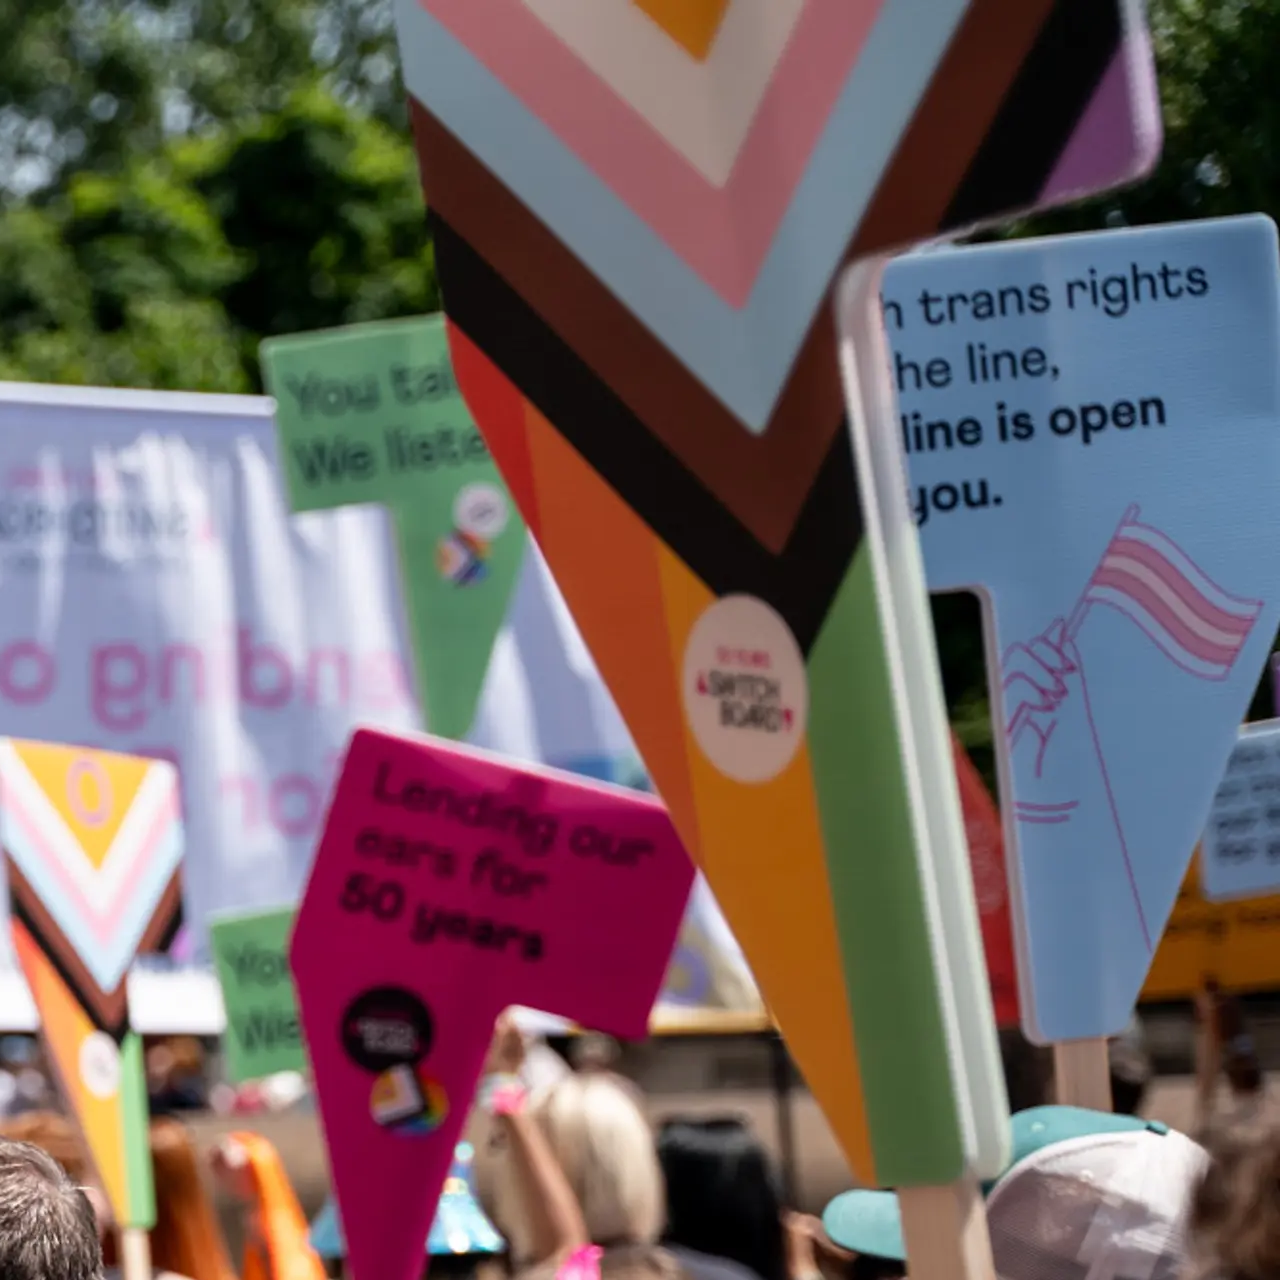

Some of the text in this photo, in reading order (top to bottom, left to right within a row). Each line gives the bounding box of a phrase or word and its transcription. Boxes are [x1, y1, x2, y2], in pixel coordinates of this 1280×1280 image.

[919, 283, 1052, 328] trans
[1067, 262, 1210, 319] rights
[285, 364, 458, 419] You ta
[894, 342, 1060, 393] he line,
[996, 402, 1036, 443] is
[1048, 396, 1167, 446] open
[295, 424, 489, 486] We liste
[371, 761, 657, 868] Lending our
[354, 826, 549, 898] ears for
[340, 871, 547, 964] 50 years
